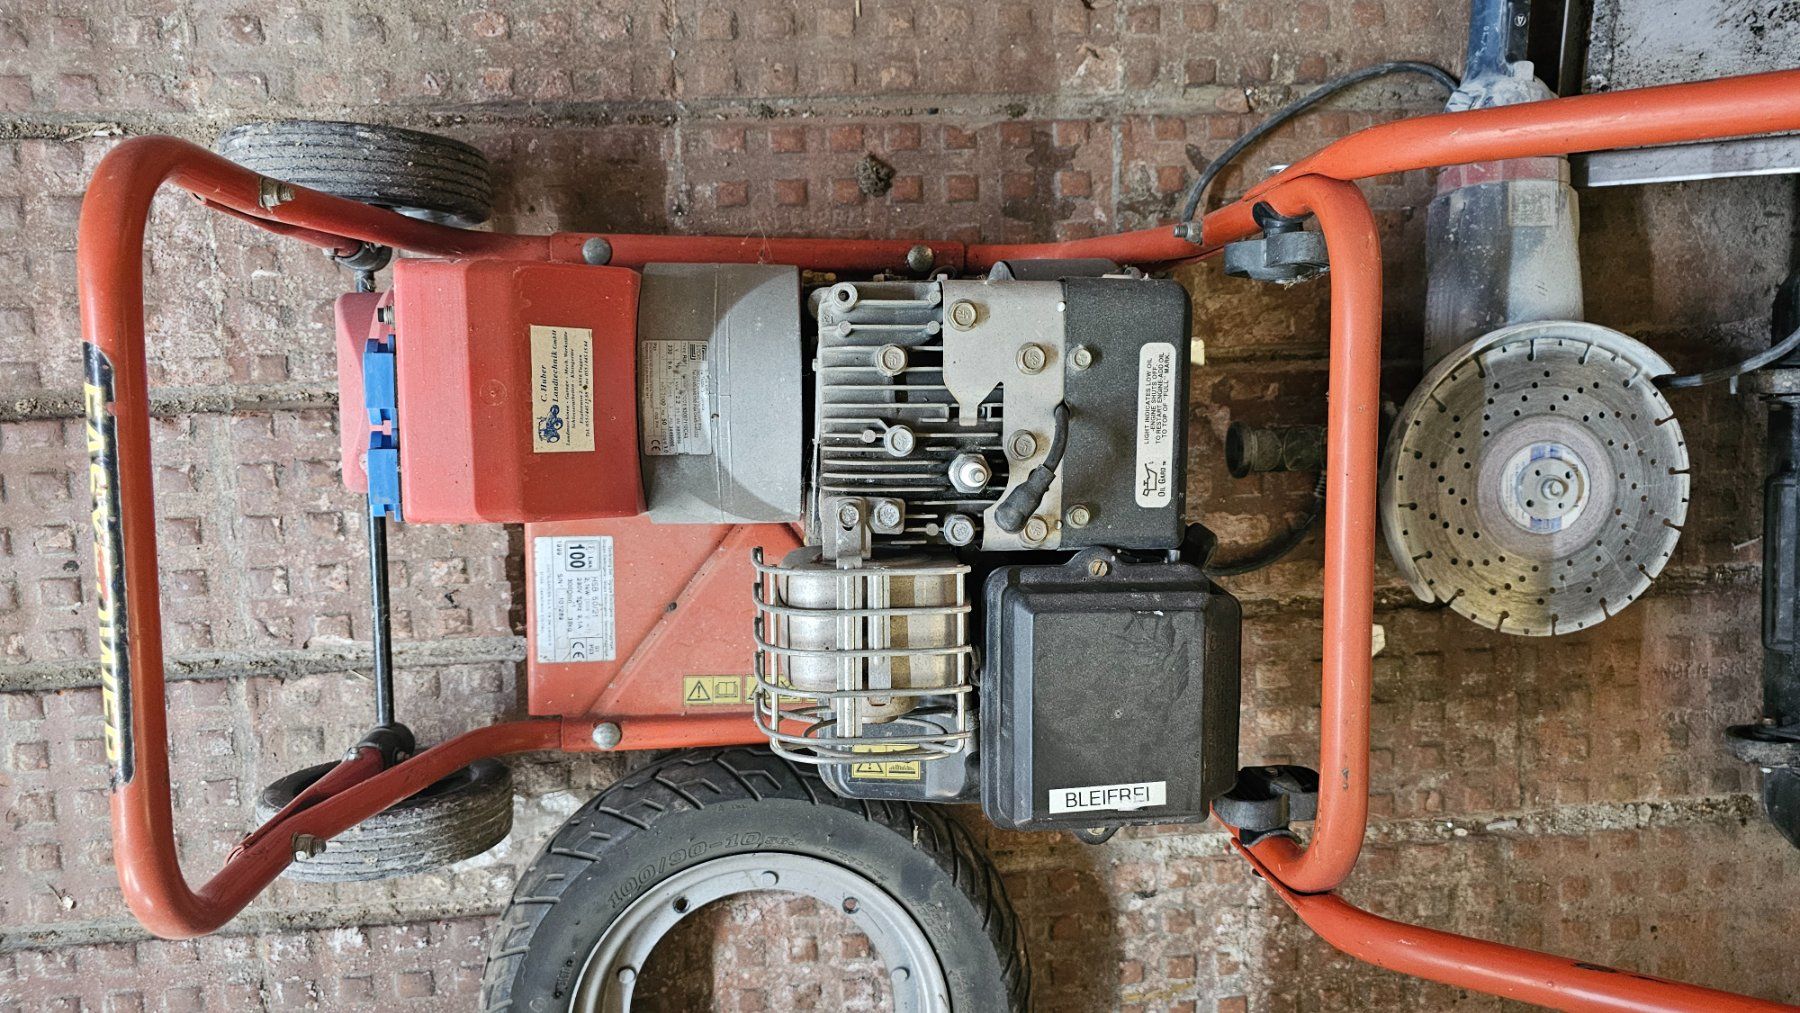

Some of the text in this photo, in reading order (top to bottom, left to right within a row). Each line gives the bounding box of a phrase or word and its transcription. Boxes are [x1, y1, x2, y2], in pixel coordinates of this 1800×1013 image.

[1162, 402, 1168, 412] OF
[1162, 430, 1167, 438] TO
[1155, 435, 1161, 444] TO
[569, 544, 586, 569] 100
[1065, 786, 1150, 808] BLEIFREI
